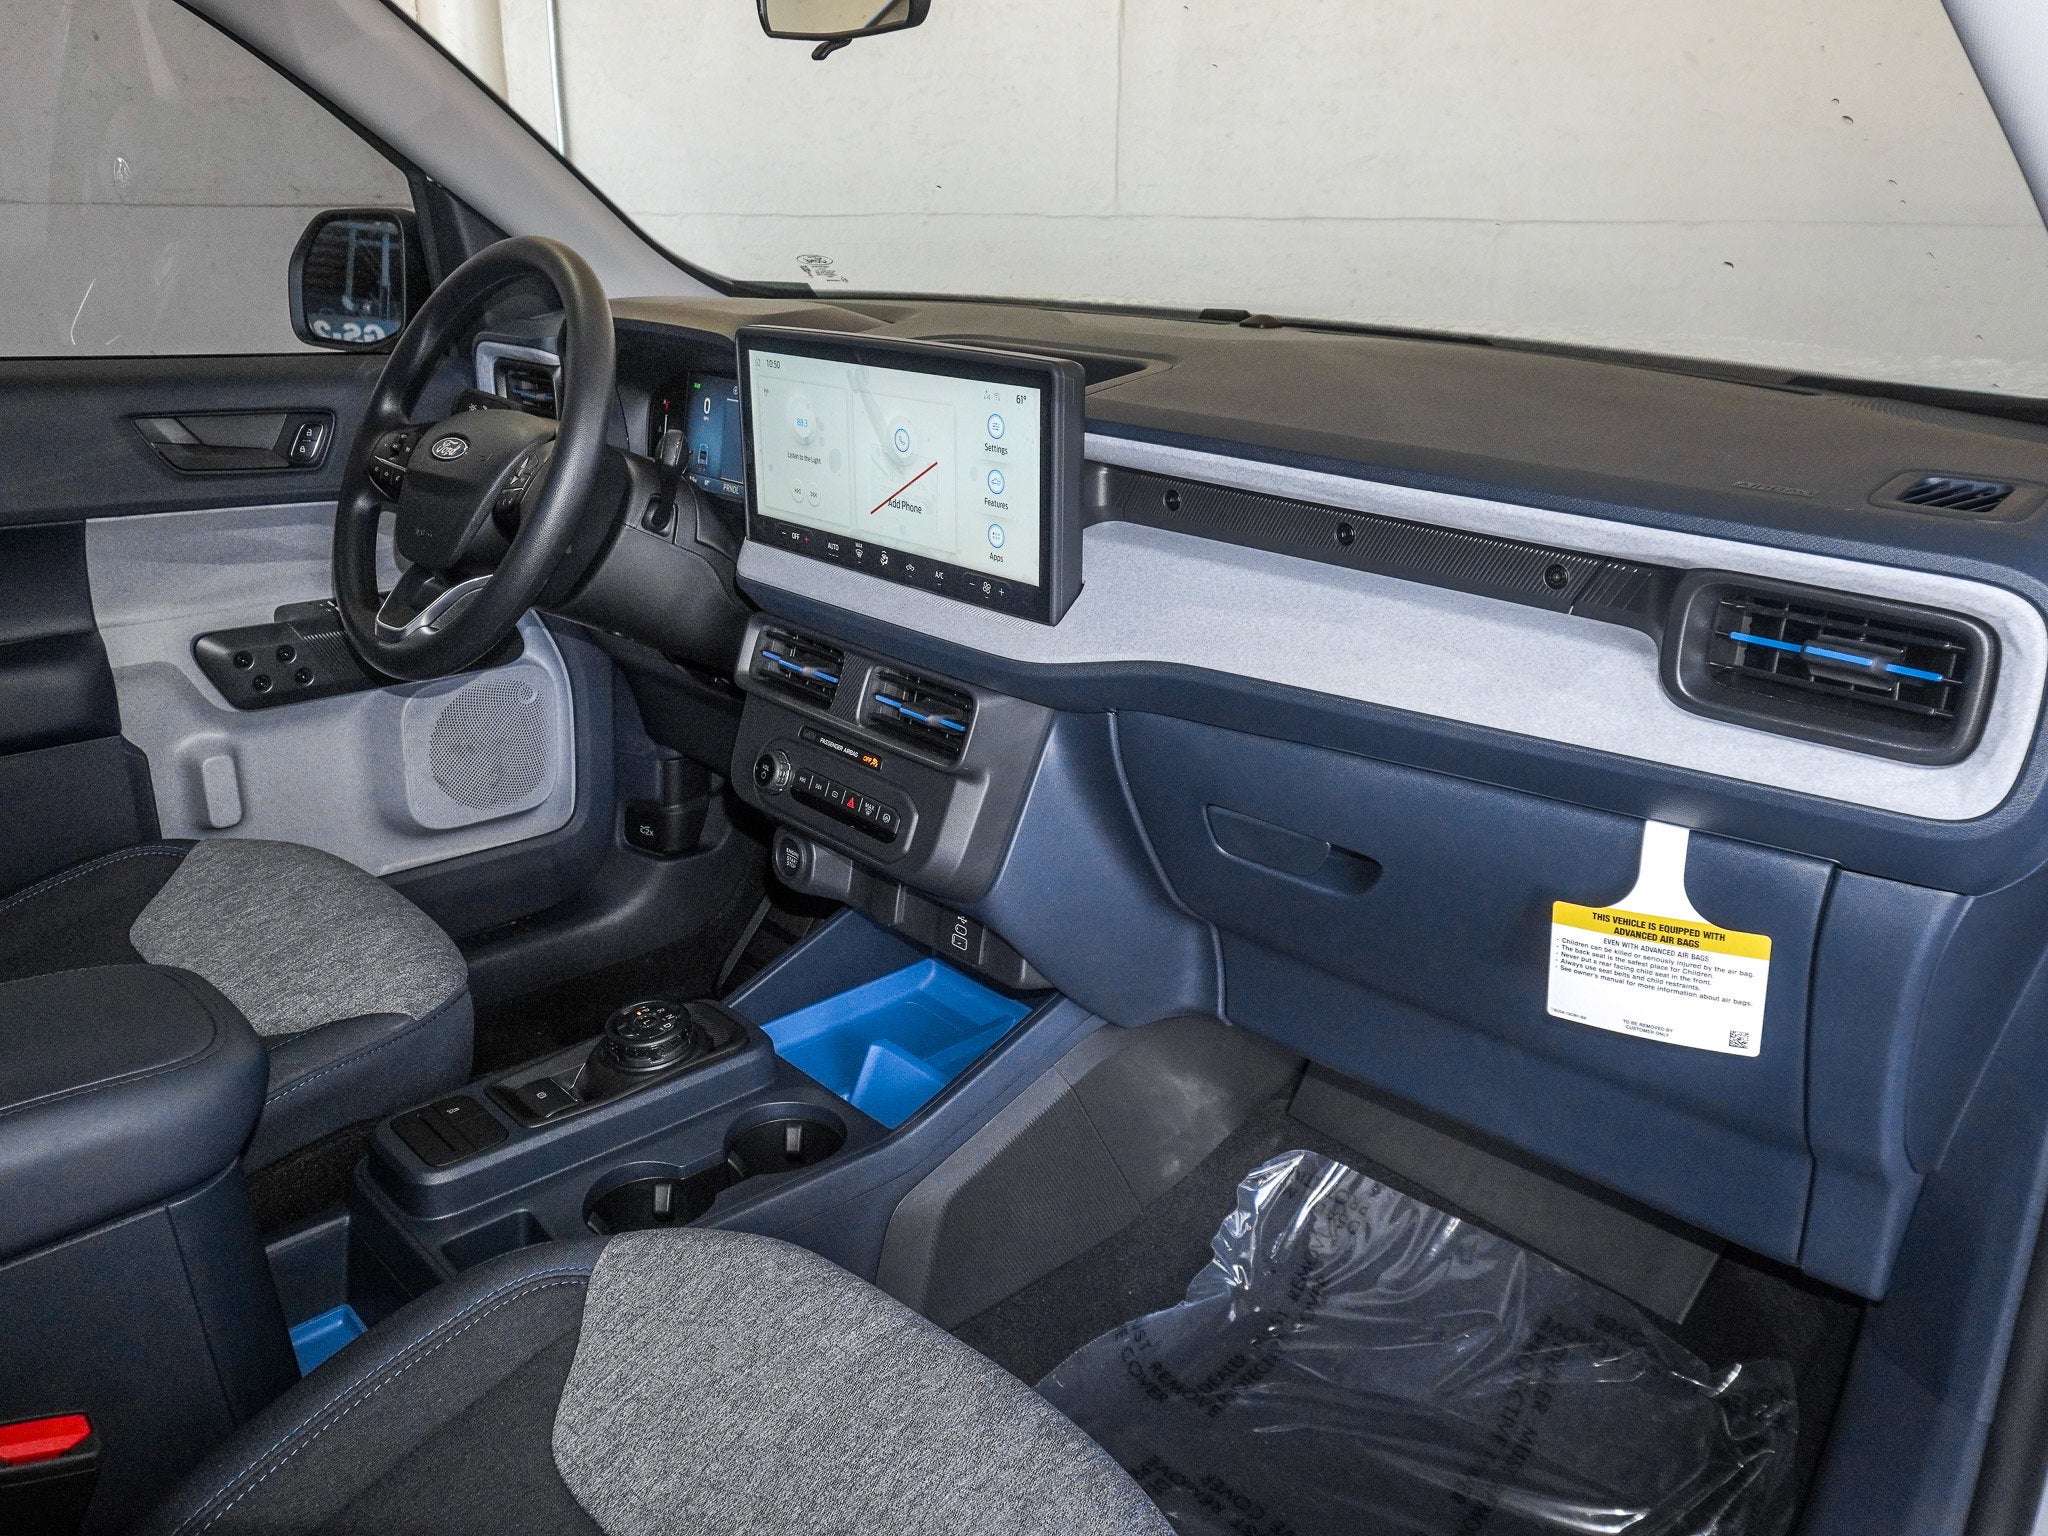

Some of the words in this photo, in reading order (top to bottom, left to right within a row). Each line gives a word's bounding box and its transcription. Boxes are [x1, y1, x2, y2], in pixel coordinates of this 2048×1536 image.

[766, 359, 781, 369] 10:50
[703, 397, 711, 415] 0
[787, 451, 799, 460] Listen
[984, 443, 1008, 455] Settings
[888, 498, 901, 509] Add
[901, 500, 922, 514] Phone
[984, 498, 1009, 510] Features
[791, 532, 800, 540] OFF
[828, 542, 839, 551] AUTO
[989, 552, 1004, 563] Apps
[935, 570, 944, 580] A/C
[820, 737, 843, 751] PASSENGER
[843, 747, 859, 757] AIRBAG
[862, 755, 872, 763] OFF
[865, 802, 875, 810] MAX
[1592, 911, 1610, 922] THIS
[1614, 915, 1646, 929] VEHICLE
[1648, 921, 1656, 930] IS
[1659, 923, 1700, 937] EQUIPPED
[1703, 930, 1725, 941] WITH
[1614, 926, 1657, 941] ADVANCED
[1660, 934, 1674, 944] AIR
[1677, 937, 1700, 948] BAGS
[1561, 937, 1589, 948] Children
[1613, 948, 1632, 957] killed
[1642, 954, 1674, 965] seriously
[1676, 960, 1701, 969] injured
[1713, 965, 1725, 973] the
[1574, 947, 1590, 955] back
[1627, 959, 1648, 967] safest
[1603, 937, 1619, 946] EVEN
[1621, 941, 1638, 950] WITH
[1640, 944, 1675, 956] ADVANCED
[1690, 952, 1709, 962] BAGS
[1560, 951, 1579, 959] Never
[1612, 962, 1634, 973] facing
[1635, 967, 1653, 975] child
[1560, 958, 1583, 968] Always
[1613, 969, 1630, 978] belts
[1645, 976, 1663, 984] child
[1559, 964, 1572, 972] See
[1572, 968, 1598, 978] owner's
[1599, 974, 1624, 984] manual
[1637, 982, 1655, 990] more
[1656, 985, 1697, 997] information
[1698, 993, 1720, 1001] about
[1624, 1024, 1654, 1034] CUSTOMER
[1121, 1346, 1169, 1403] COVER
